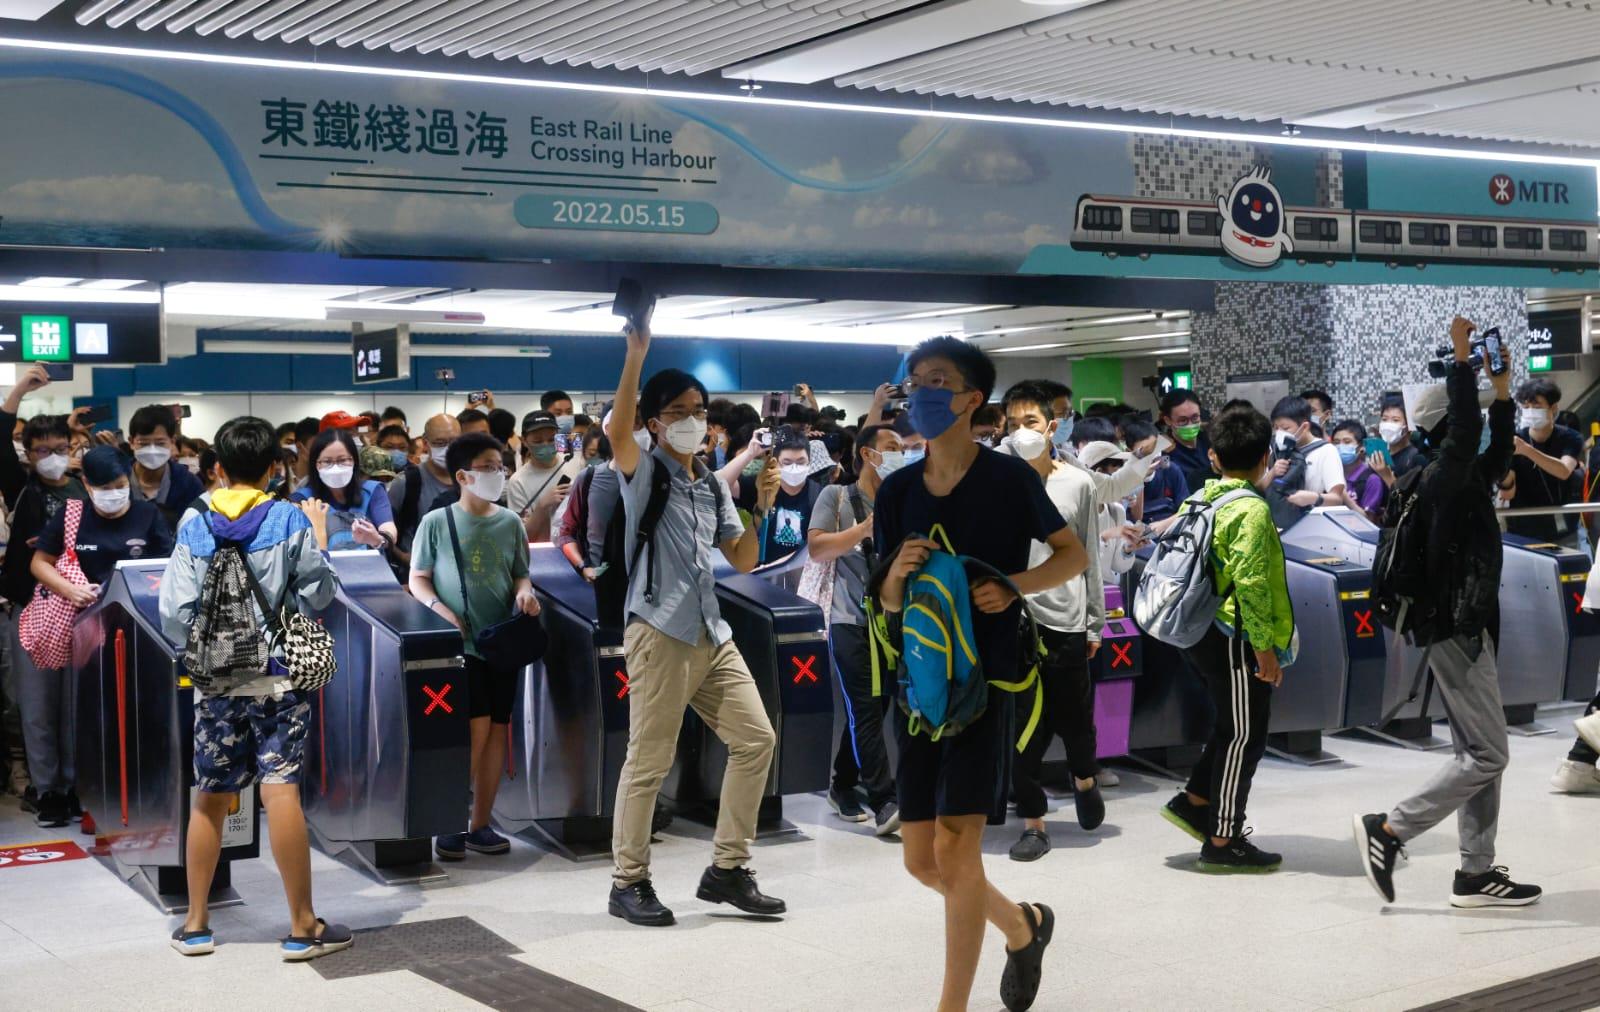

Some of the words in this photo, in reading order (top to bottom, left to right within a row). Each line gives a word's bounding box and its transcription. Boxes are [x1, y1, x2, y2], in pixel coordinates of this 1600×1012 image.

[260, 97, 509, 159] 東鐵綫過海
[530, 116, 577, 138] East
[584, 119, 622, 141] Rail
[630, 123, 673, 144] Line
[530, 140, 624, 169] Crossing
[632, 147, 717, 170] Harbour
[1519, 180, 1569, 204] MTR
[552, 200, 686, 227] 2022.05.15
[31, 321, 61, 345] 出
[83, 328, 102, 350] A
[1527, 328, 1553, 342] 中心
[32, 345, 60, 355] EXIT
